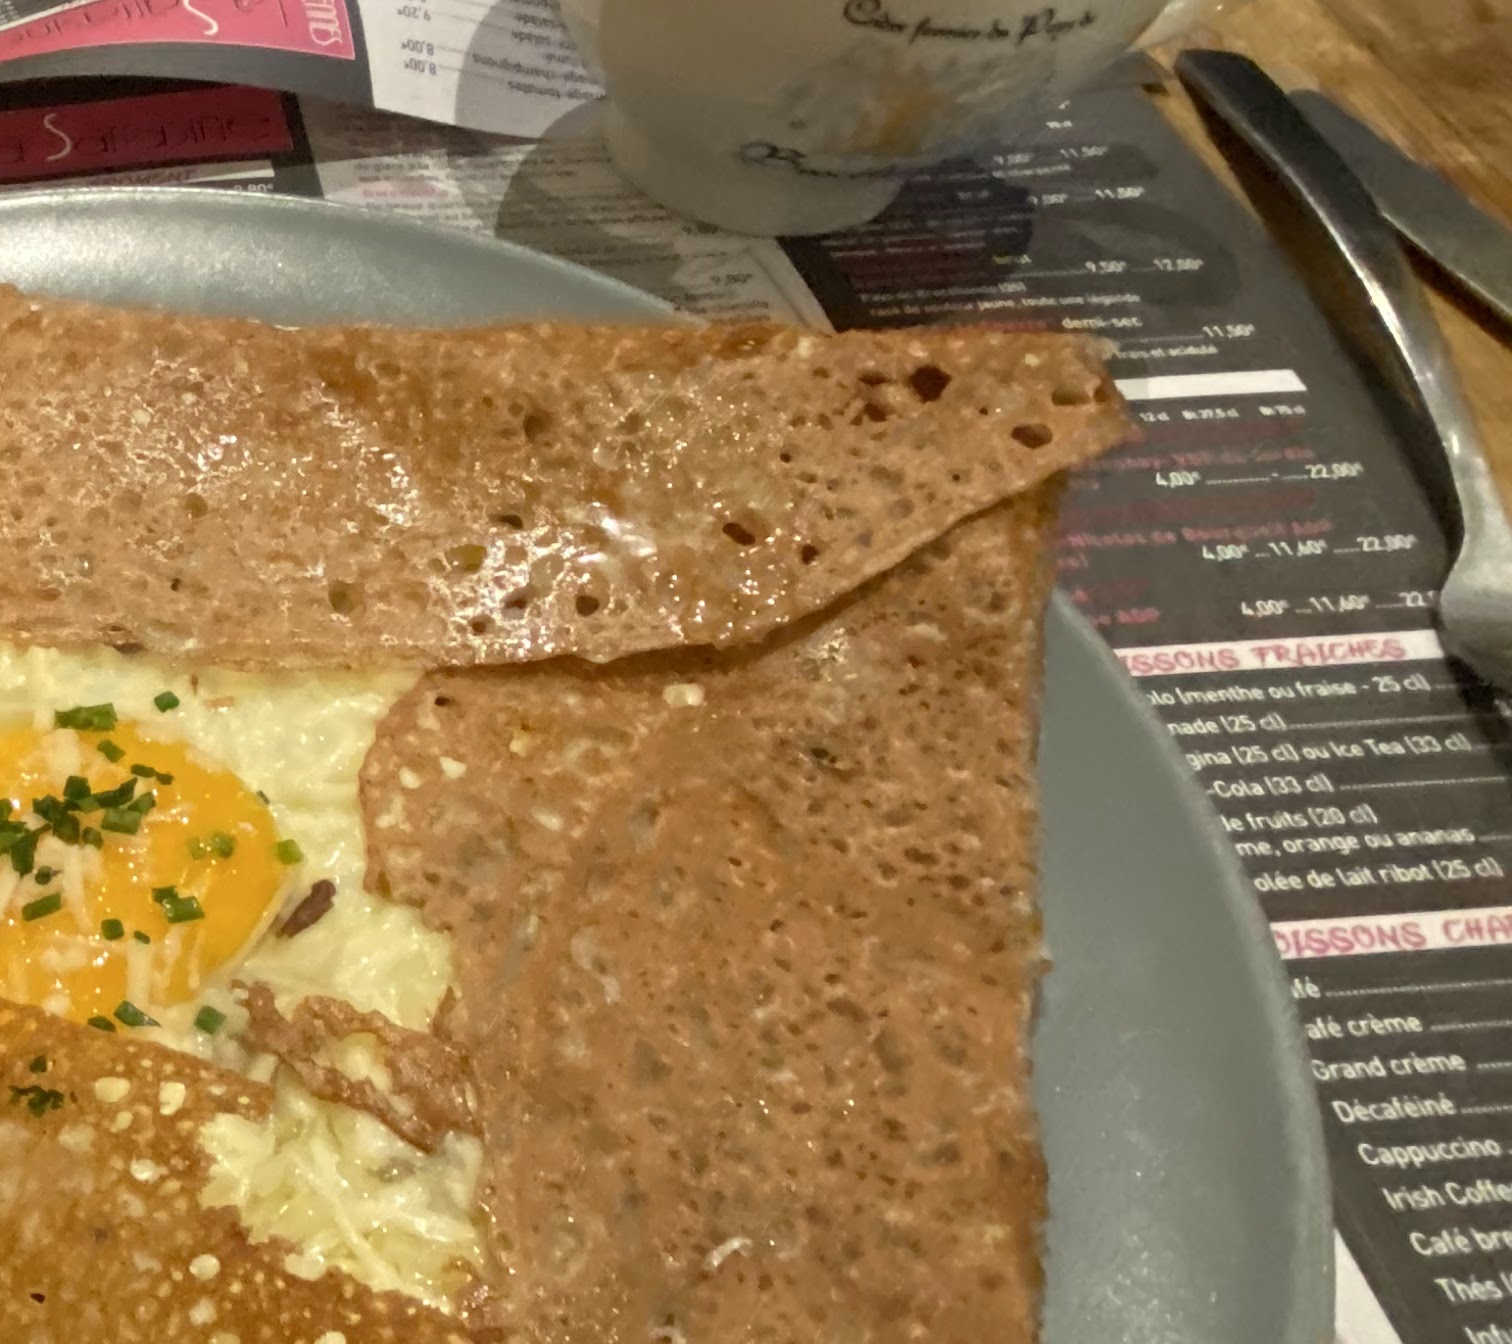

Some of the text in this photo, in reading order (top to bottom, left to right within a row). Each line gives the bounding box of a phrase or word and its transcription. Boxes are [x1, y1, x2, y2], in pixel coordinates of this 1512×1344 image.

[1268, 685, 1295, 699] ou
[1295, 680, 1358, 698] fraise
[1372, 675, 1401, 693] 25
[1302, 745, 1331, 760] ou
[1363, 738, 1406, 756] Tea
[1246, 811, 1309, 830] fruits
[1282, 827, 1476, 855] orange ou ananas
[1306, 869, 1336, 888] de
[1335, 865, 1377, 886] lait
[1378, 863, 1434, 883] ribot
[1347, 1013, 1423, 1037] crème
[1310, 1051, 1467, 1082] Grand crème
[1331, 1093, 1457, 1125] Décaféiné
[1358, 1137, 1503, 1169] Cappuccino
[1382, 1185, 1446, 1210] Irish
[1409, 1227, 1474, 1256] Café
[1434, 1274, 1503, 1303] Thés
